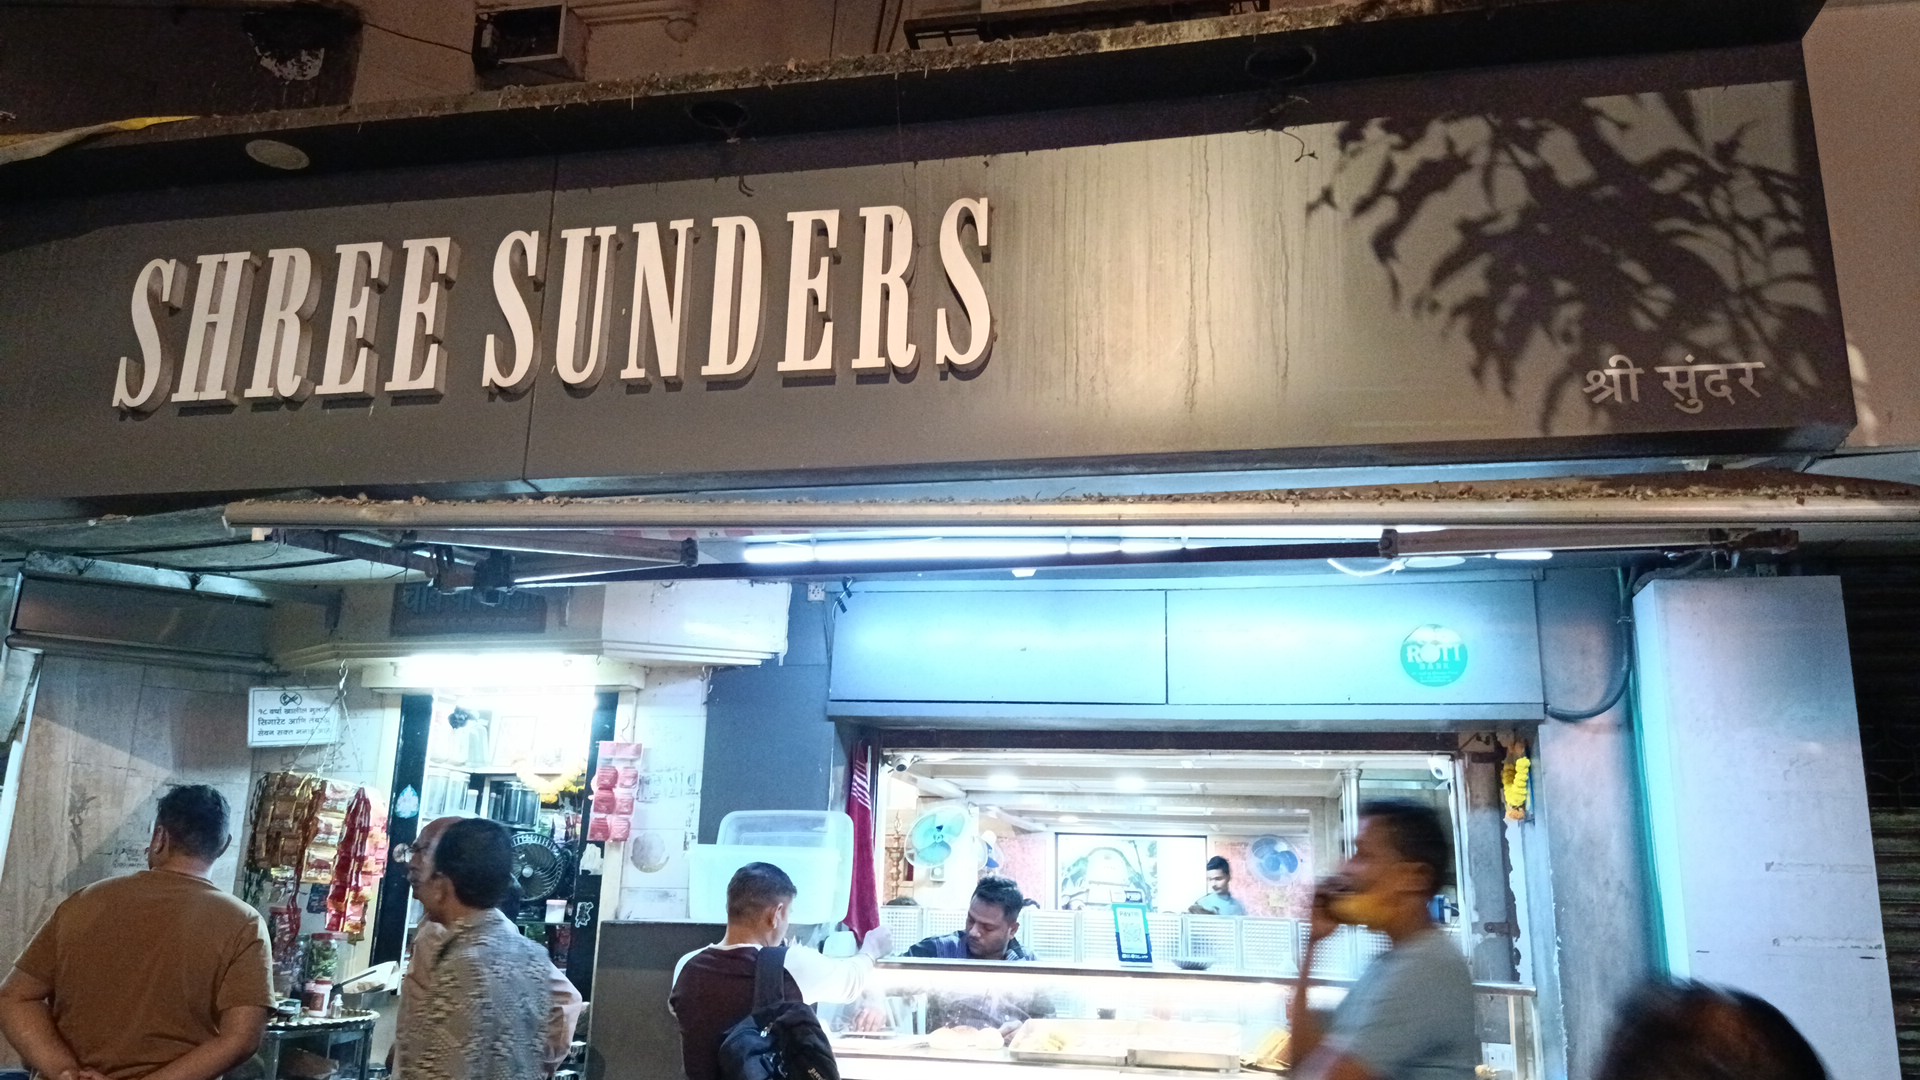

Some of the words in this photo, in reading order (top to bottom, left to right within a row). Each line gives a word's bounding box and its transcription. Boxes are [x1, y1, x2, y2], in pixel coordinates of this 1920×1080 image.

[112, 236, 455, 408] SHREE
[482, 197, 991, 388] SUNDERS
[1583, 354, 1645, 403] श्री
[1654, 353, 1766, 414] सुंदर
[1406, 643, 1461, 664] ROTI
